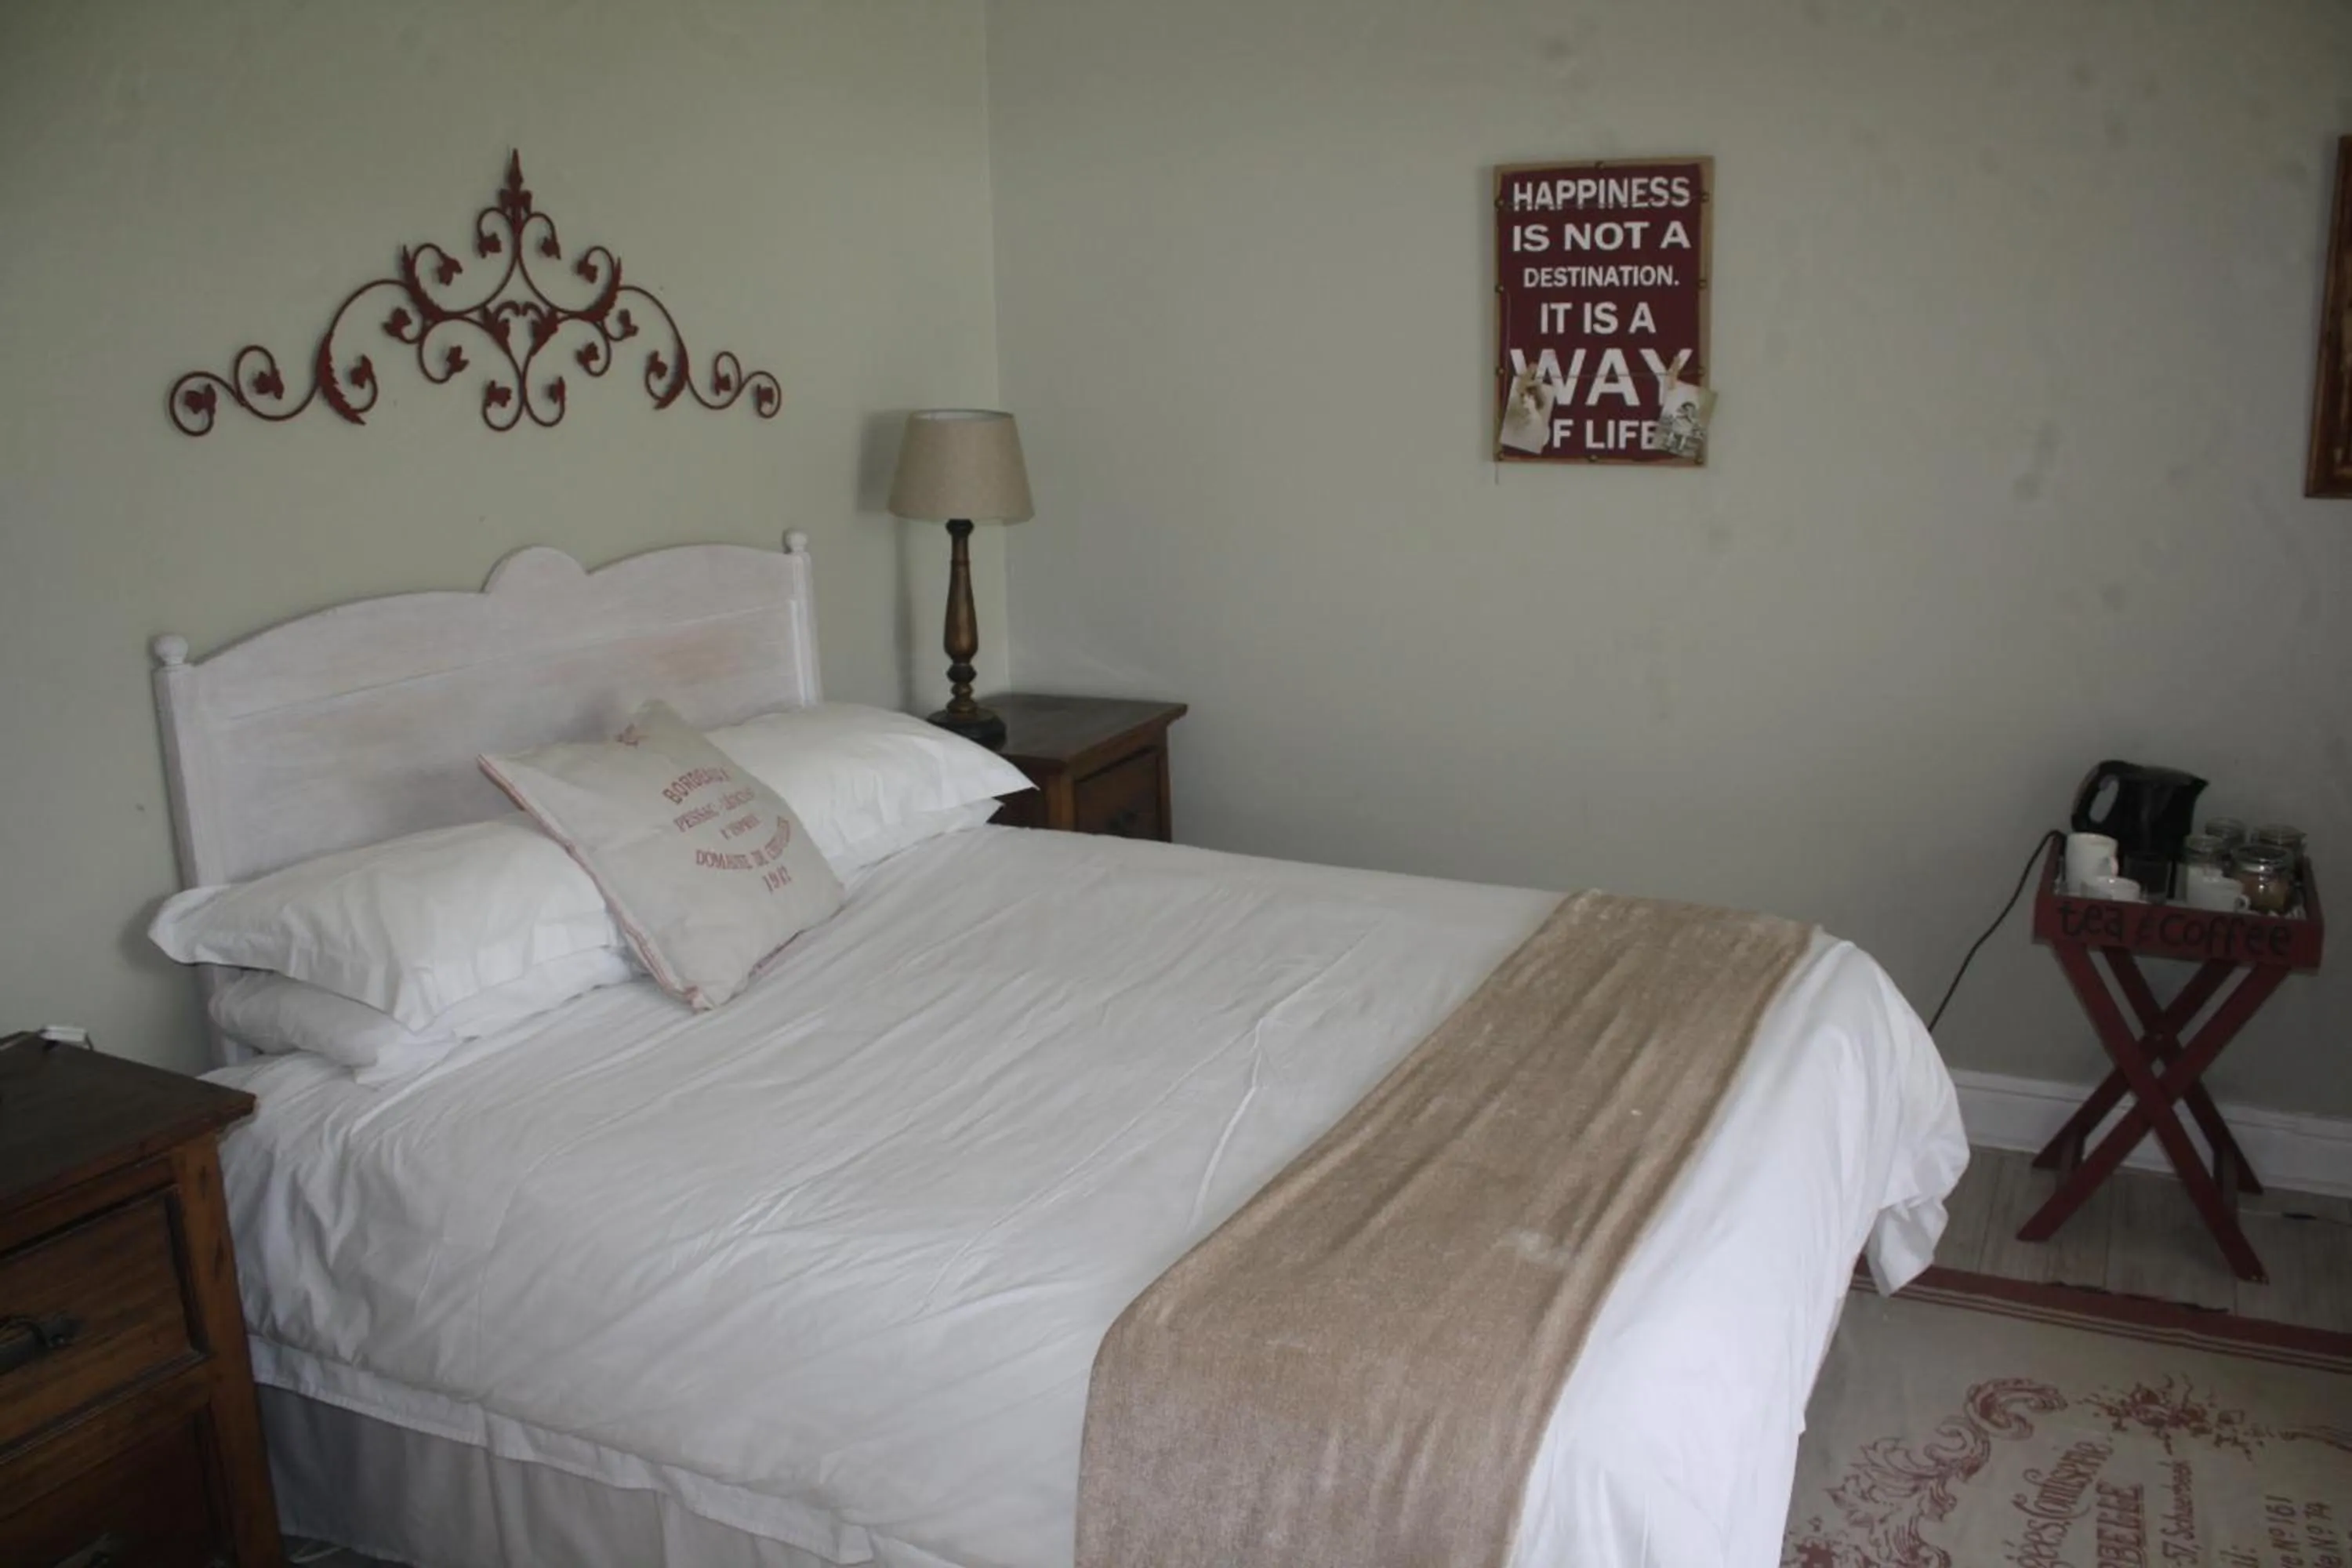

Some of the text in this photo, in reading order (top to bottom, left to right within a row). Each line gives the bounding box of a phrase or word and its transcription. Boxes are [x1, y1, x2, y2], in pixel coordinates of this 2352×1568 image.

[1513, 177, 1691, 212] HAPPINESS
[1512, 220, 1691, 252] IS NOT A
[1523, 265, 1680, 289] DESTINATION.
[1540, 302, 1657, 335] IT IS A
[1509, 348, 1693, 407] WAY
[2055, 902, 2124, 937] tea
